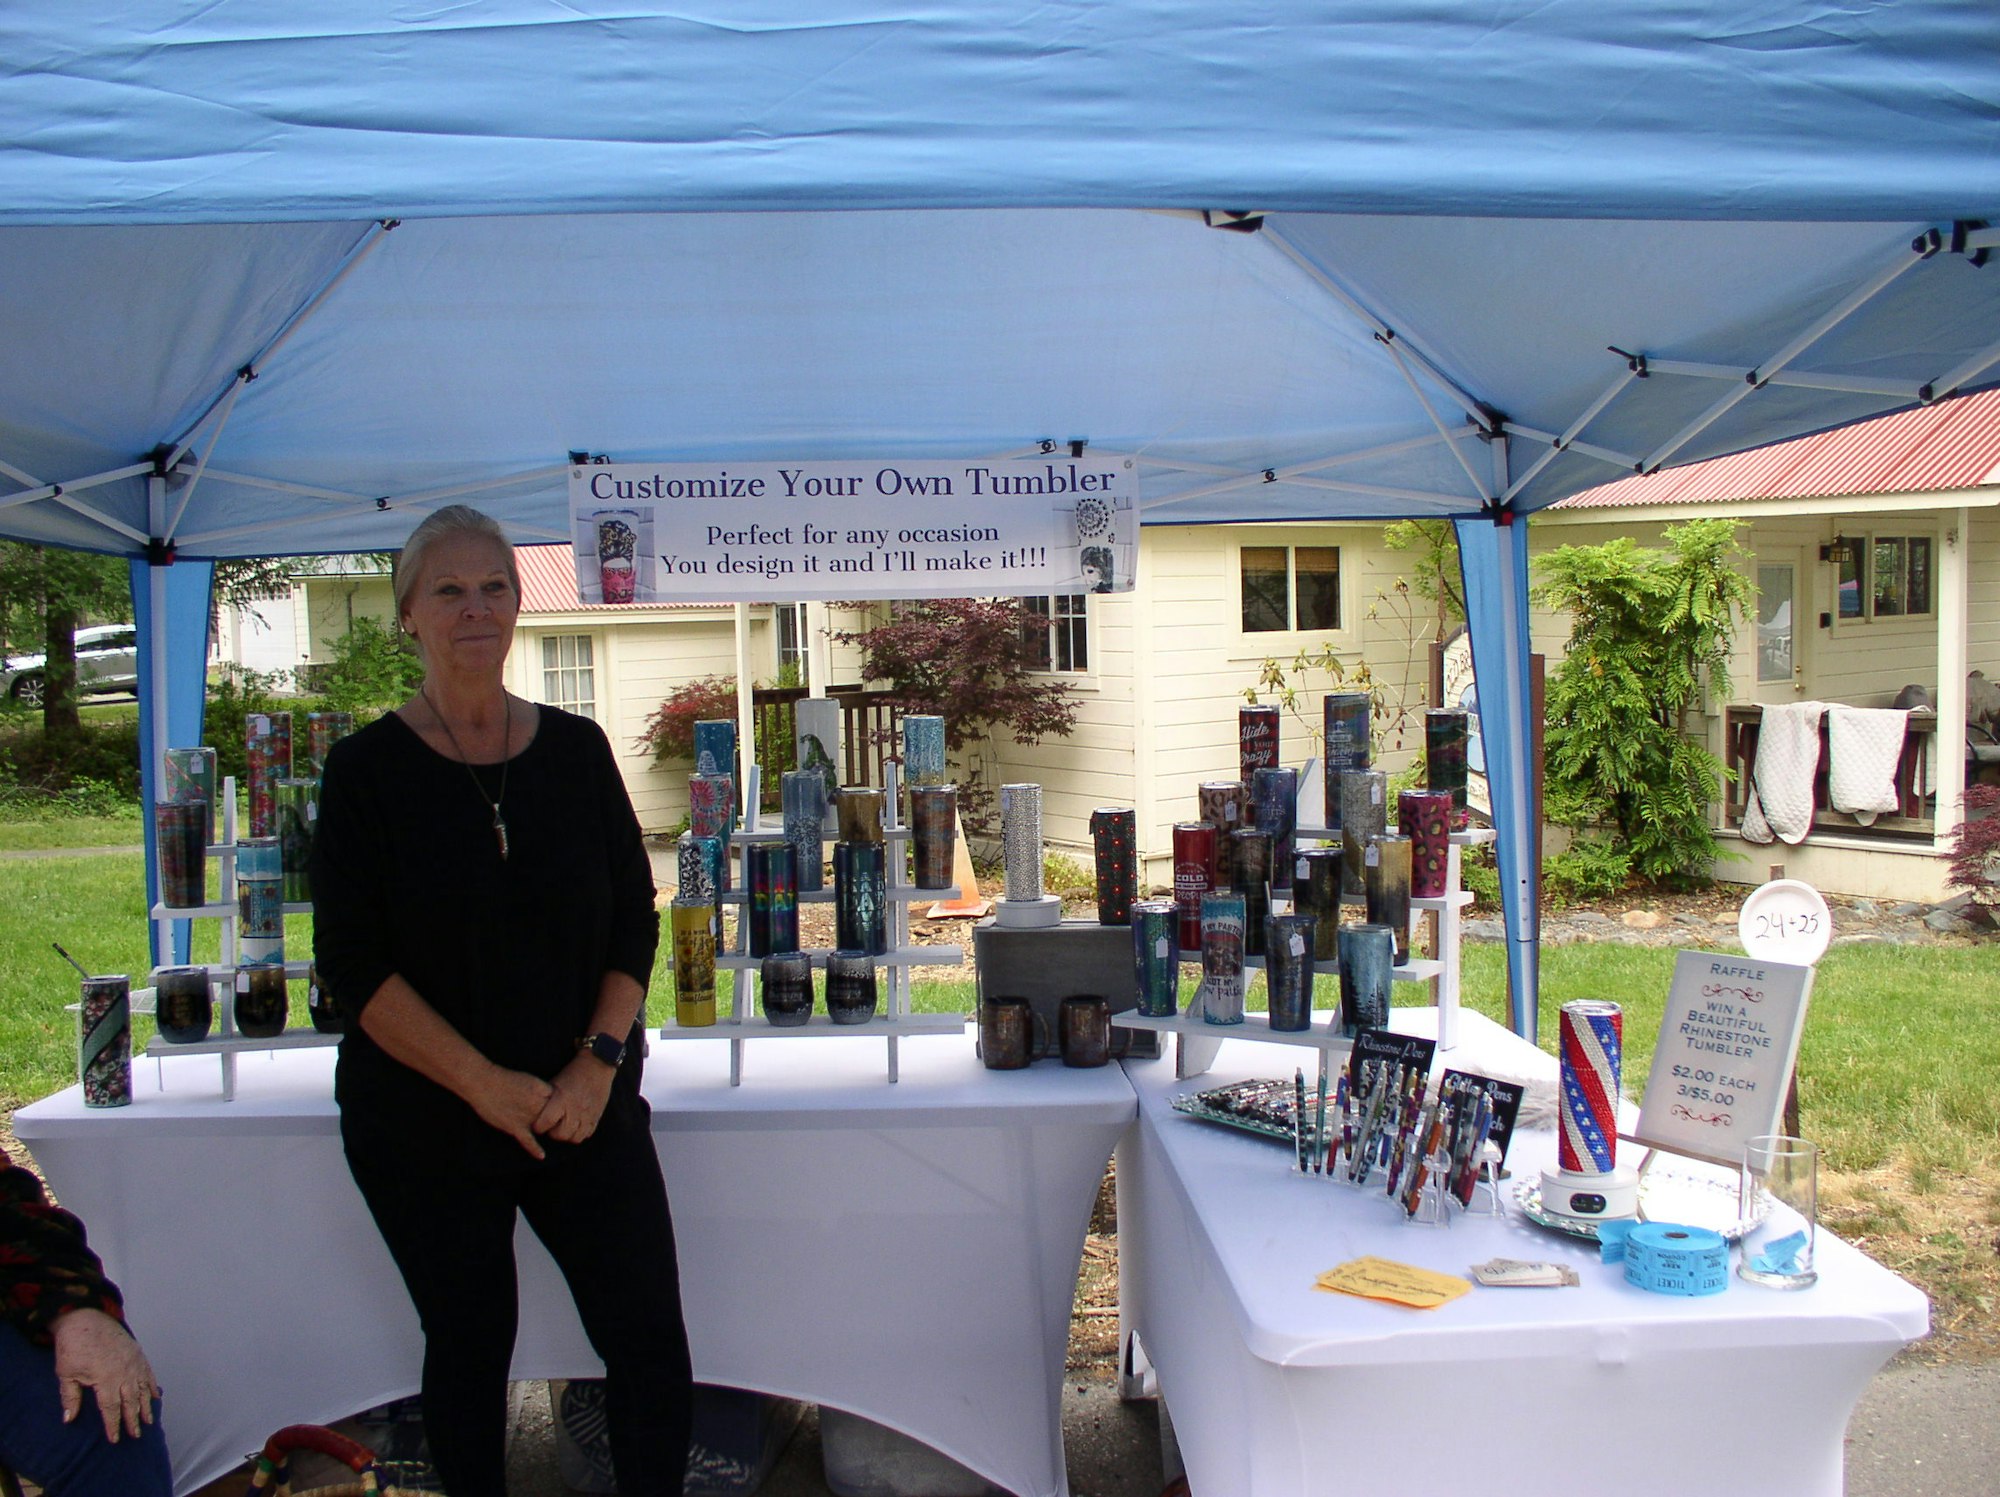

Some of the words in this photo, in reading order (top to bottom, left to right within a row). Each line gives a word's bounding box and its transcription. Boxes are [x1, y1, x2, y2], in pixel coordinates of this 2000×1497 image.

[590, 472, 766, 499] Customize
[777, 469, 864, 497] Your
[876, 468, 954, 496] Own
[965, 464, 1116, 496] Tumbler
[707, 524, 794, 545] Perfect
[803, 523, 838, 544] for
[846, 529, 890, 549] any
[899, 524, 1000, 544] occasion
[661, 555, 707, 575] You
[716, 553, 791, 580] design
[803, 554, 820, 573] it
[829, 552, 873, 573] and
[883, 551, 916, 572] I'll
[925, 550, 992, 571] make
[1001, 547, 1047, 569] it!!!
[1710, 962, 1765, 981] RAFFLE
[1706, 1001, 1734, 1015] WIN
[1737, 1007, 1747, 1017] A
[1687, 1009, 1767, 1033] BEAUTIFUL
[1679, 1022, 1772, 1048] RHINESTONE
[1686, 1036, 1754, 1058] TUMBLER
[1671, 1064, 1715, 1083] $2.00
[1718, 1075, 1756, 1092] EACH
[1486, 1081, 1514, 1104] Pens
[1676, 1084, 1735, 1106] 3/$5.00
[1657, 1277, 1686, 1290] TICKET
